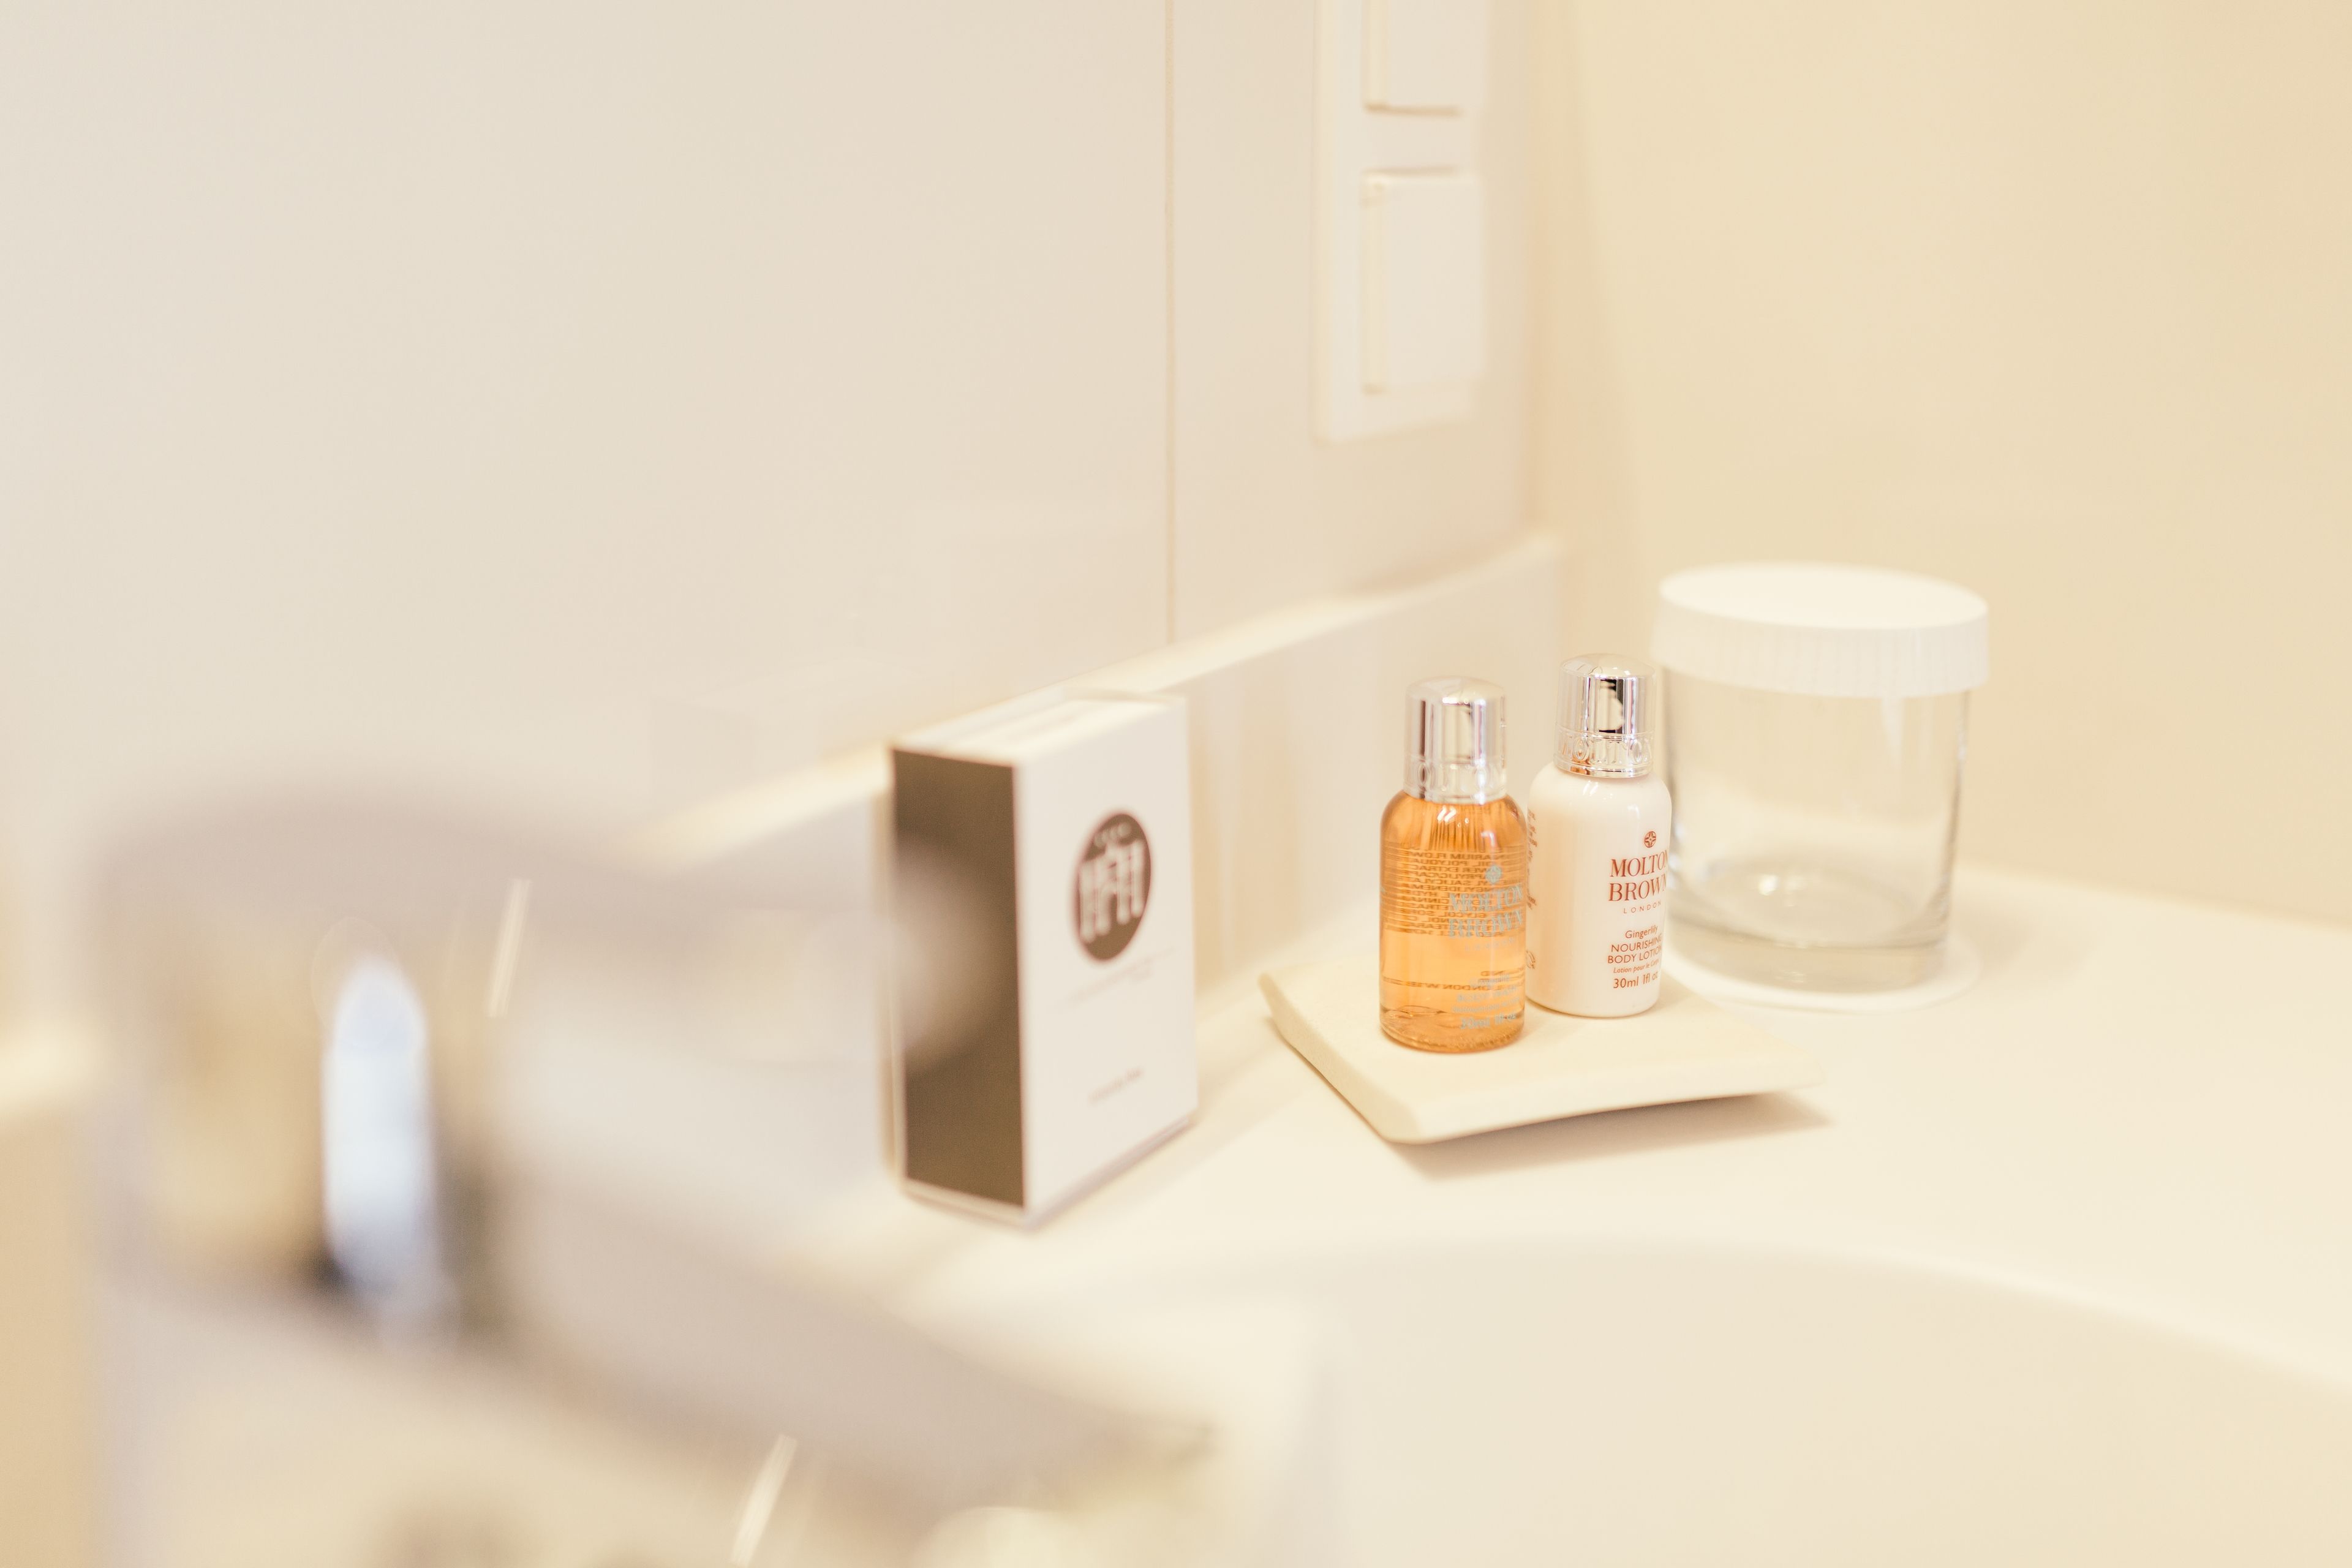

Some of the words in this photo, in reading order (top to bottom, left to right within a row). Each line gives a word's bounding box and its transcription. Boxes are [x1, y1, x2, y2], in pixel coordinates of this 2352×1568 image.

[1608, 873, 1666, 902] BROWN
[1623, 901, 1661, 914] LONDON
[1607, 954, 1637, 964] BODY
[1613, 976, 1639, 989] 30ml
